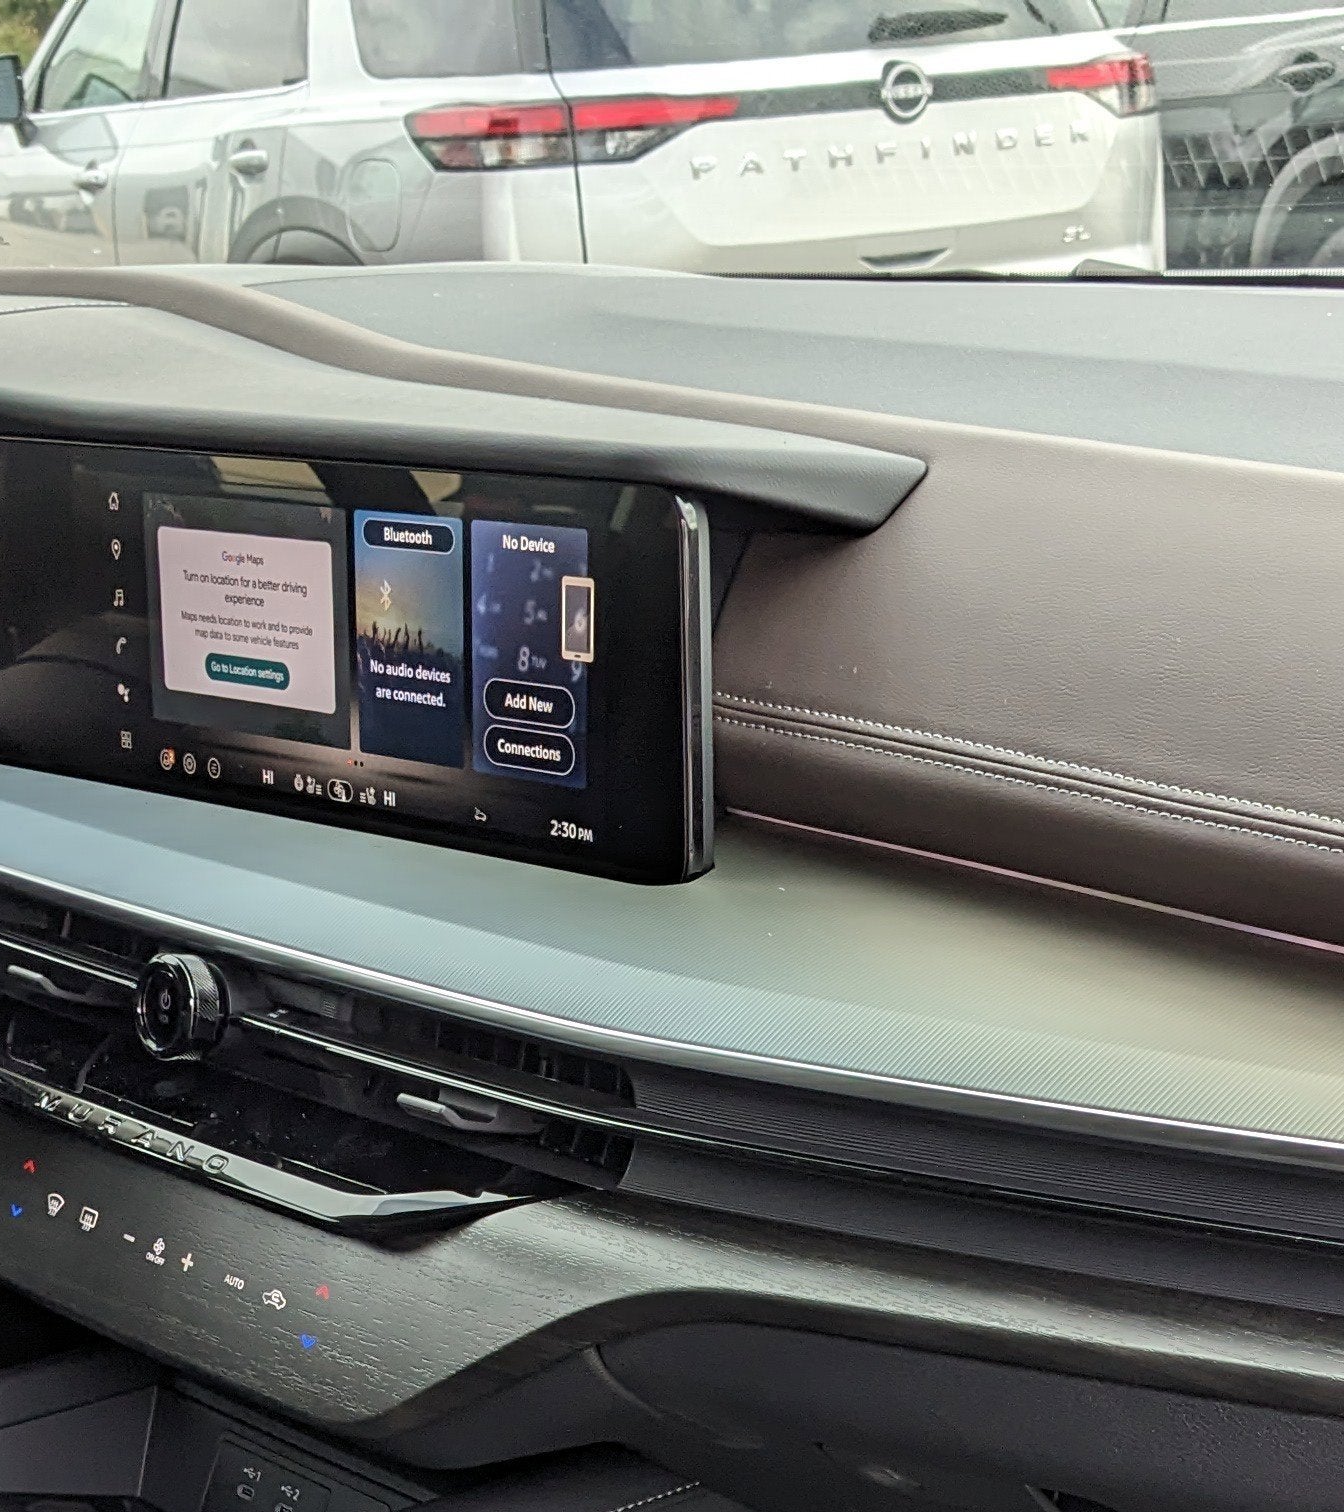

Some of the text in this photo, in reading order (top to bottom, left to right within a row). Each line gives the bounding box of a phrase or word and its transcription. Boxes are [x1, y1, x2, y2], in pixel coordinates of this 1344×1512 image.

[689, 119, 1090, 181] PATHFINDER
[383, 526, 433, 546] Bluetooth
[502, 534, 556, 554] No Device
[221, 550, 265, 567] Google Maps
[182, 569, 199, 582] Turn
[200, 574, 210, 584] on
[210, 573, 240, 588] location
[240, 576, 252, 589] for
[258, 579, 281, 592] better
[281, 582, 308, 598] driving
[224, 593, 266, 608] experience
[181, 610, 314, 637] Maps needs location to work and to provide
[209, 629, 224, 640] data
[224, 631, 232, 641] to
[232, 633, 249, 644] some
[250, 634, 273, 647] vehicle
[273, 637, 300, 651] features
[210, 661, 285, 684] Go to Location settings
[370, 659, 452, 684] No audio devices
[375, 686, 447, 708] are connected.
[504, 692, 554, 714] Add New
[497, 738, 562, 763] Connections
[262, 769, 274, 786] HI
[383, 789, 396, 808] HI
[550, 819, 594, 843] 2:30 PM
[35, 1091, 230, 1175] MURANO
[223, 1274, 245, 1290] AUTO
